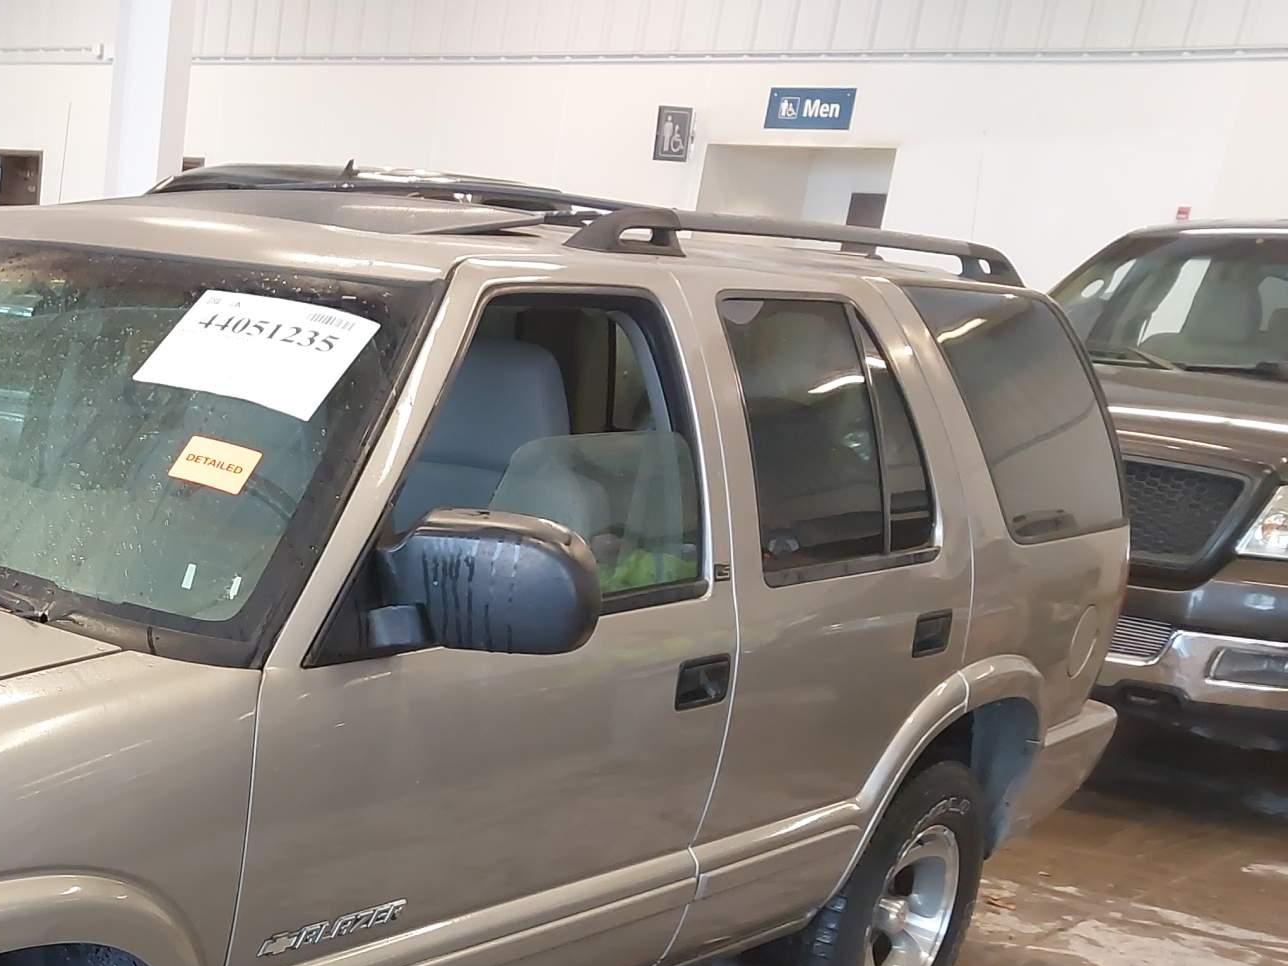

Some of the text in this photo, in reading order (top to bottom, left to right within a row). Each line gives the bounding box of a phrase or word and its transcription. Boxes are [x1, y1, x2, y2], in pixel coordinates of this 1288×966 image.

[802, 98, 841, 119] Men
[198, 313, 340, 352] 44051235
[185, 453, 243, 475] DETAILED
[295, 899, 407, 949] BLAZER
